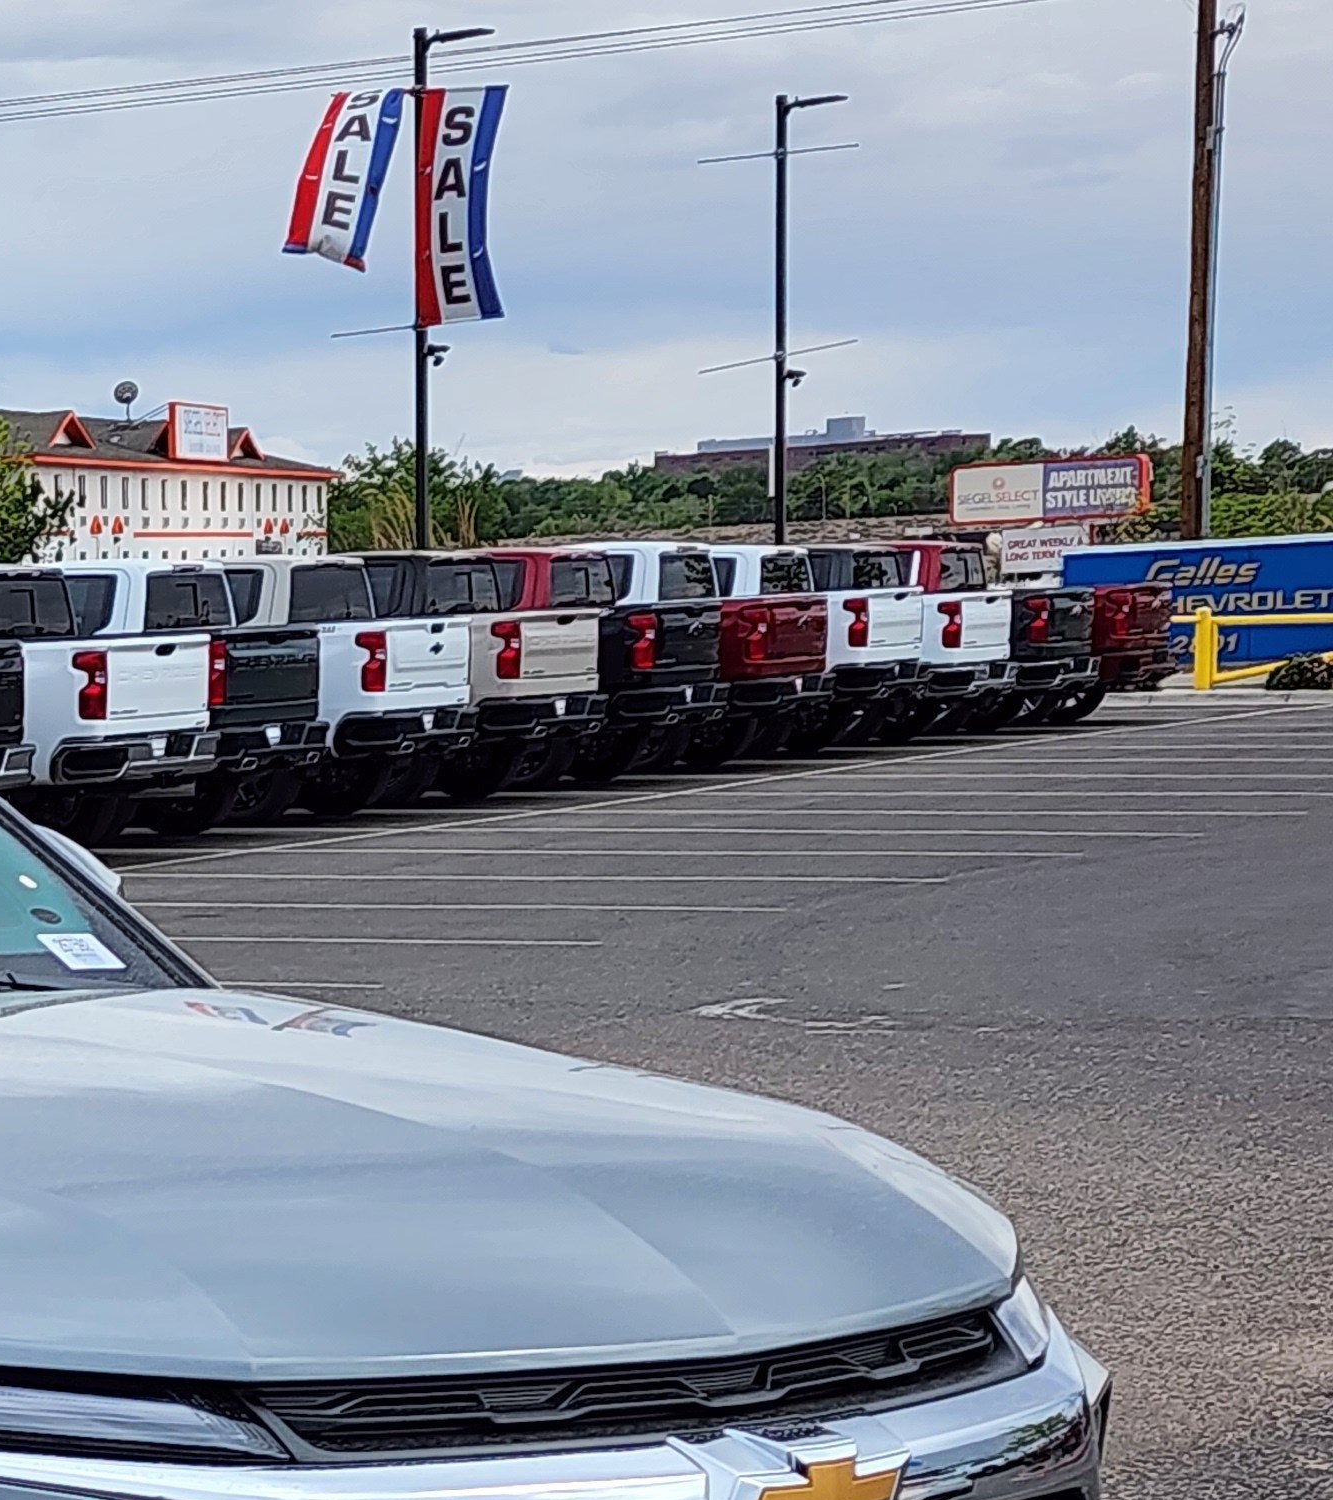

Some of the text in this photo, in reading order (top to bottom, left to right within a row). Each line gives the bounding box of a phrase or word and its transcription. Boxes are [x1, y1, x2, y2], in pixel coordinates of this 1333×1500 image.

[321, 89, 383, 232] SALE
[433, 106, 476, 306] SALE
[995, 489, 1039, 503] SELECT
[1046, 489, 1089, 509] STYLE
[1007, 538, 1038, 550] GREAT
[1040, 536, 1075, 547] WEEKLY
[1005, 551, 1029, 562] LONG
[1032, 550, 1056, 561] TERM
[1145, 556, 1262, 587] Galles
[1171, 589, 1333, 614] HEVROLET
